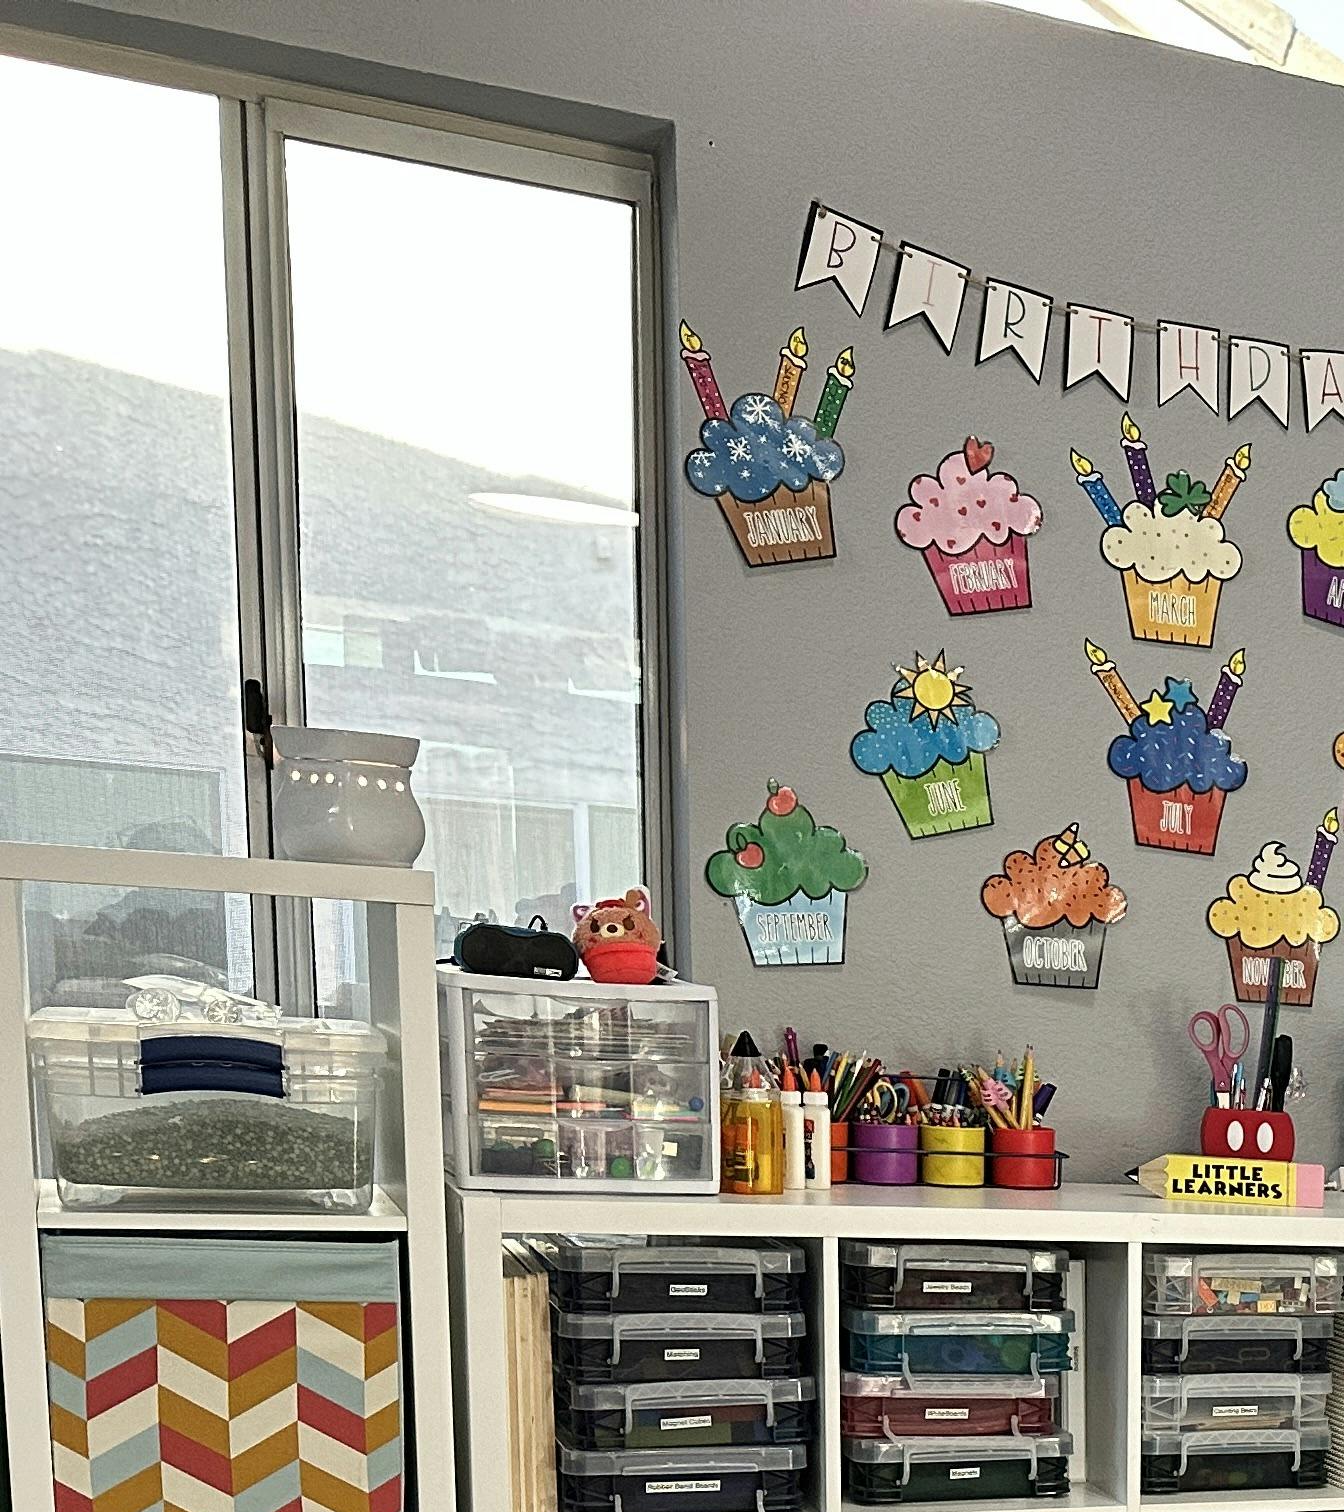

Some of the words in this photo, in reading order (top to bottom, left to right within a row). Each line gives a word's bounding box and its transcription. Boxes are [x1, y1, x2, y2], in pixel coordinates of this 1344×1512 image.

[746, 505, 823, 548] JANUARY
[949, 558, 1015, 594] FEBRUARY
[1148, 594, 1196, 626] MARCH
[928, 778, 966, 815] JUNE
[1160, 801, 1191, 834] JULY
[757, 907, 830, 943] SEPTEMBER
[1022, 939, 1085, 971] OCTOBER
[1171, 1179, 1284, 1200] LEARNERS
[1191, 1163, 1264, 1183] LITTLE
